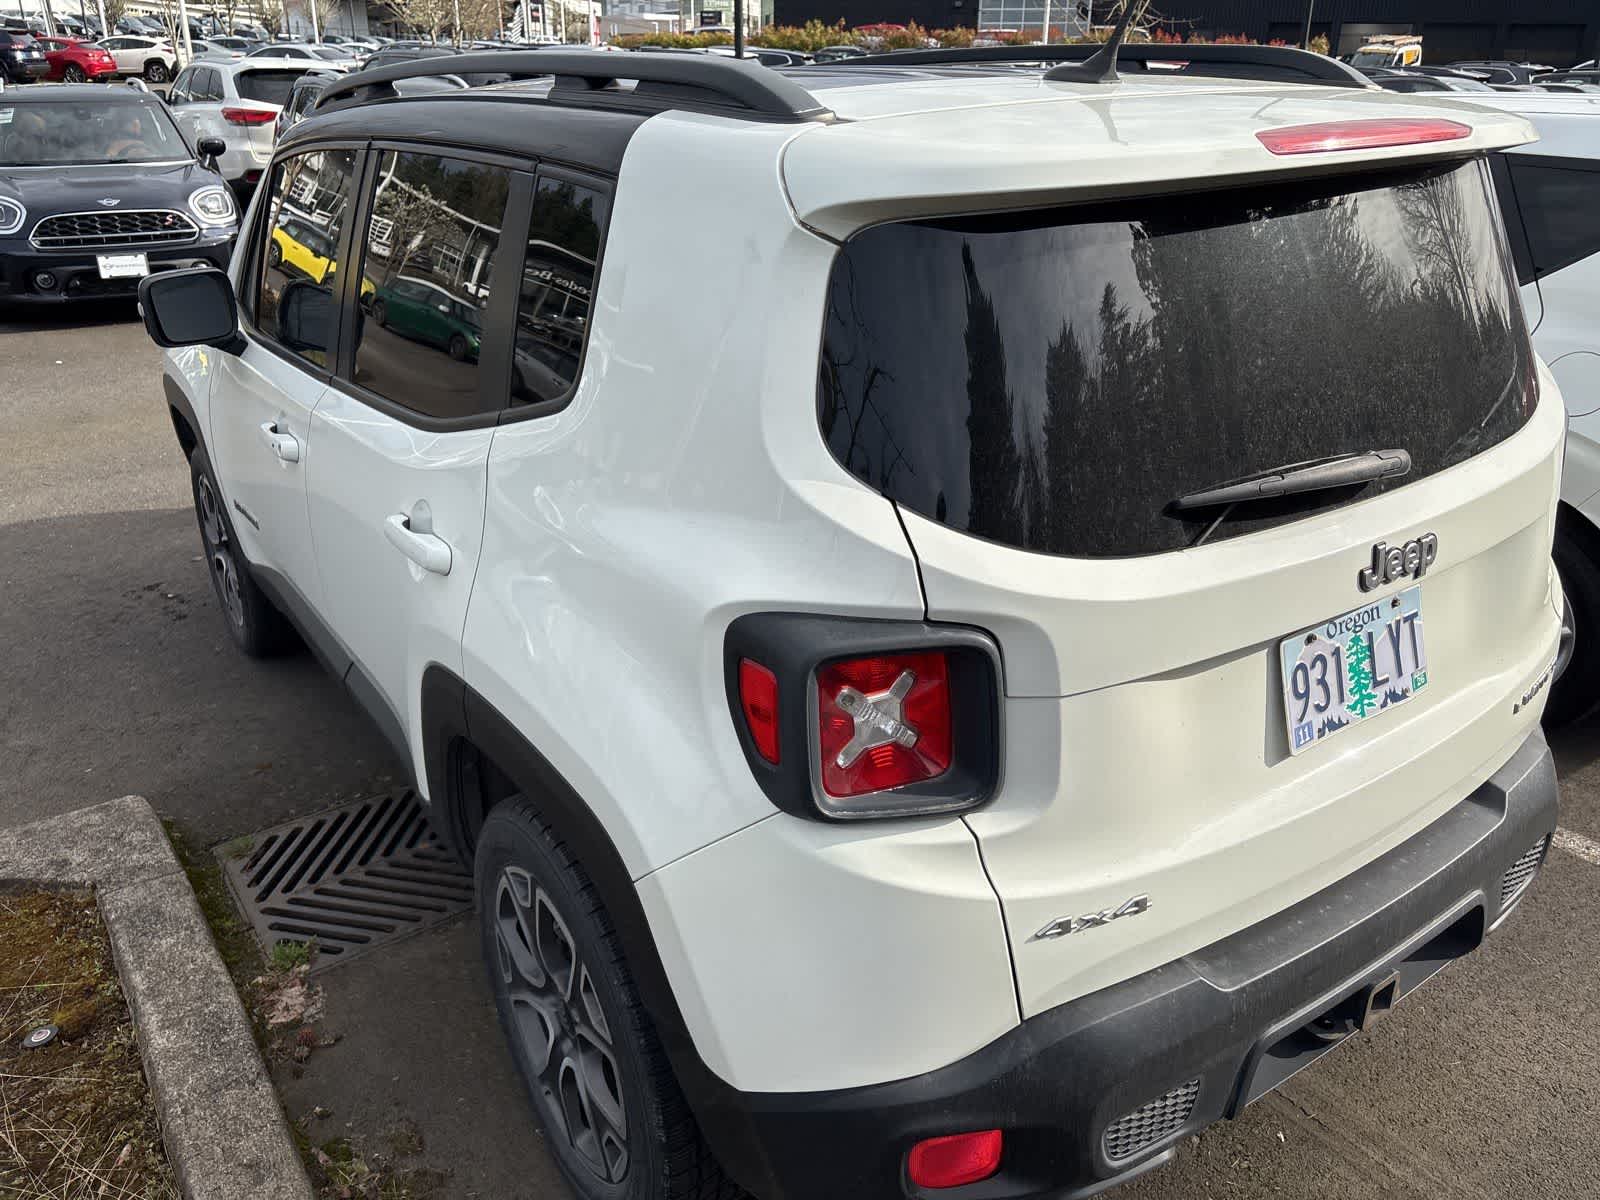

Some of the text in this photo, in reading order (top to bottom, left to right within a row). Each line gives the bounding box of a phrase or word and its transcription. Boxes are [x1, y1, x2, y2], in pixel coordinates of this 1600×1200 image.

[1357, 532, 1438, 593] Jeep
[1326, 605, 1381, 639] Oregon
[1291, 647, 1345, 723] 931
[1367, 609, 1419, 689] LYT
[1298, 724, 1312, 746] 11
